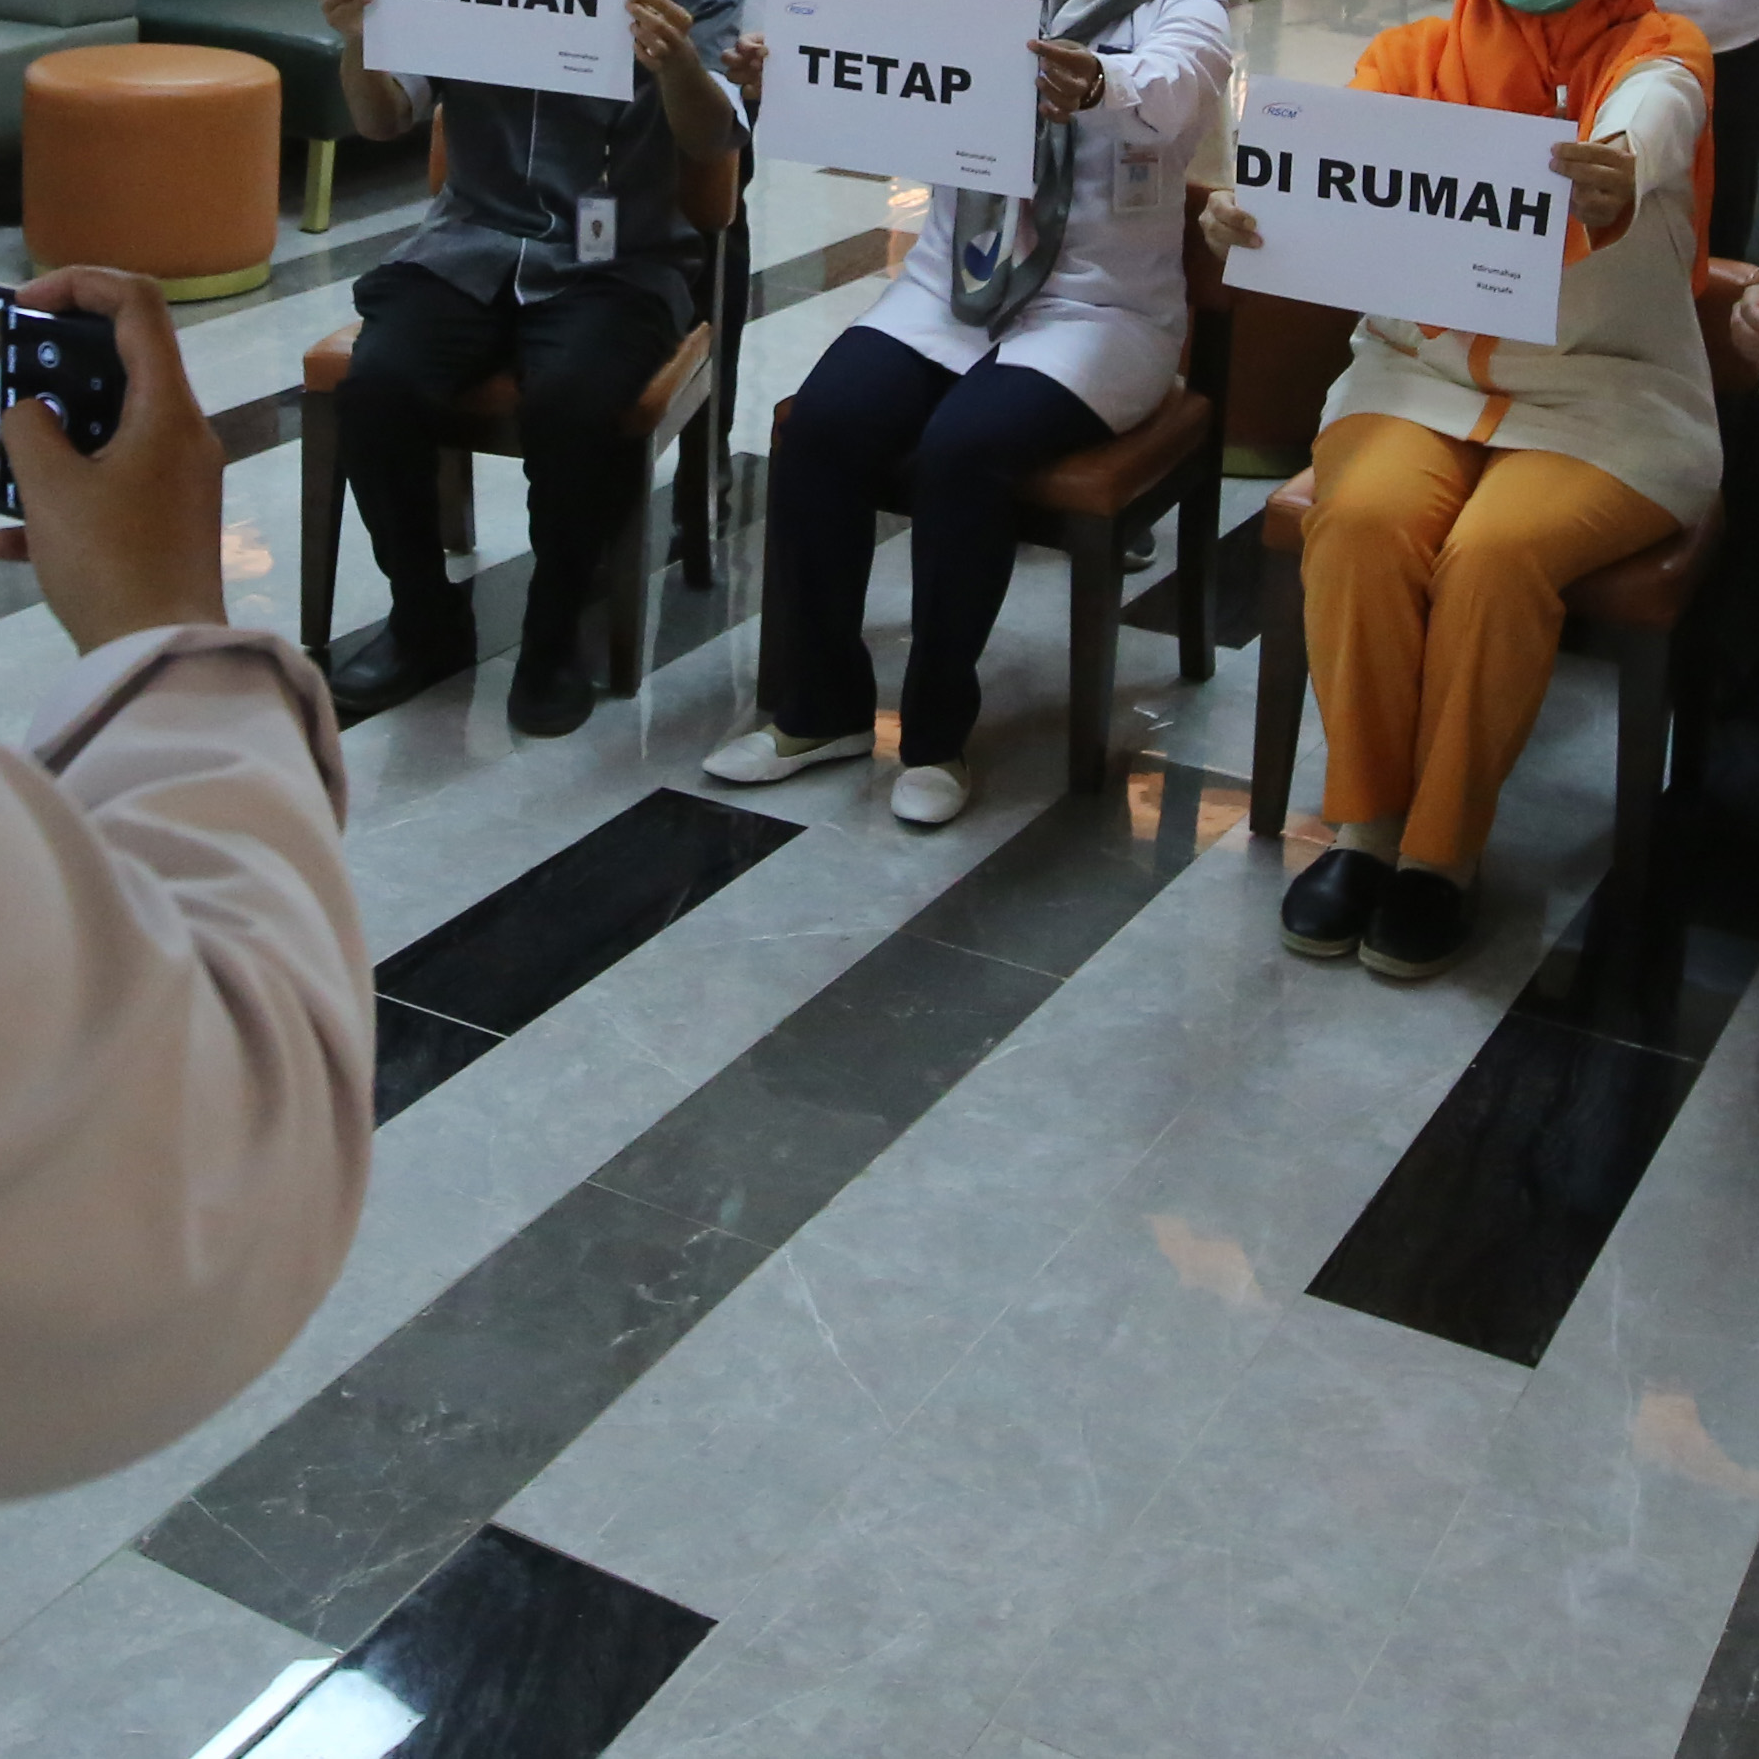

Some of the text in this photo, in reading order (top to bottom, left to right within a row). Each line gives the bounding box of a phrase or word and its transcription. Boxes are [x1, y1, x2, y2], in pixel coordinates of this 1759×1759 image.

[798, 45, 972, 105] TETAP
[1236, 144, 1552, 237] DI RUMAH
